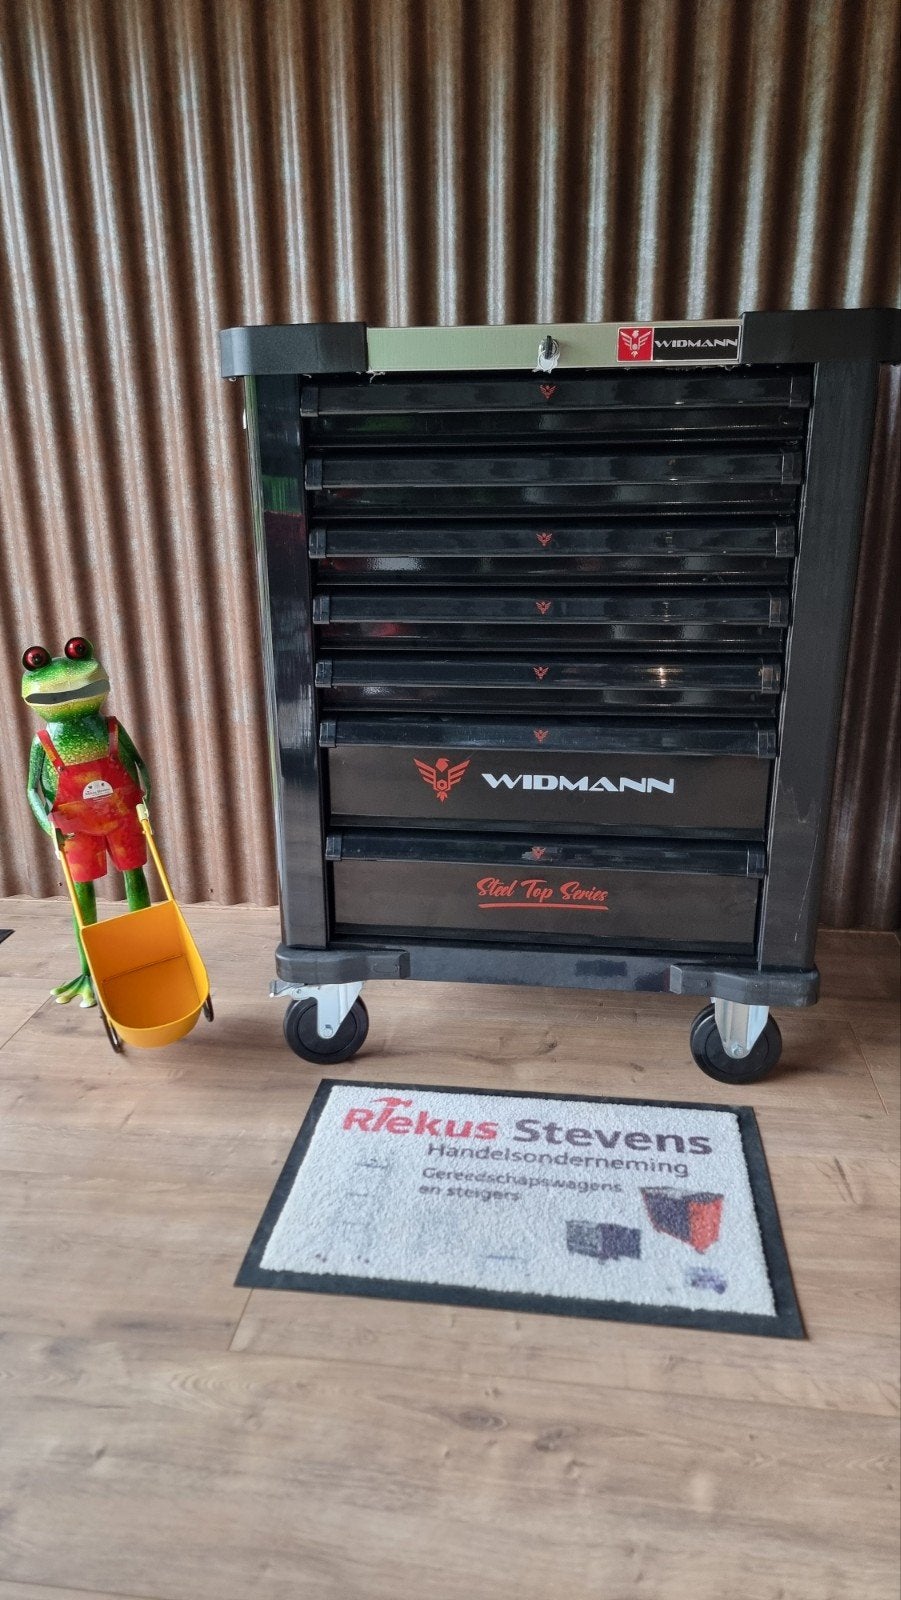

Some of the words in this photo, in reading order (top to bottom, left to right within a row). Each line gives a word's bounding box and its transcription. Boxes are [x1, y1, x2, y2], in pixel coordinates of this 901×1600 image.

[654, 339, 738, 348] WIDMANN
[481, 773, 675, 794] WIDMANN
[476, 877, 518, 897] Steel
[521, 879, 554, 903] Top
[560, 881, 609, 902] Series
[513, 1118, 713, 1155] Stevens
[427, 1142, 689, 1178] Handelsonderneming
[419, 1184, 441, 1196] en
[446, 1185, 521, 1201] steigers
[422, 1167, 622, 1193] Gereedschapswagens
